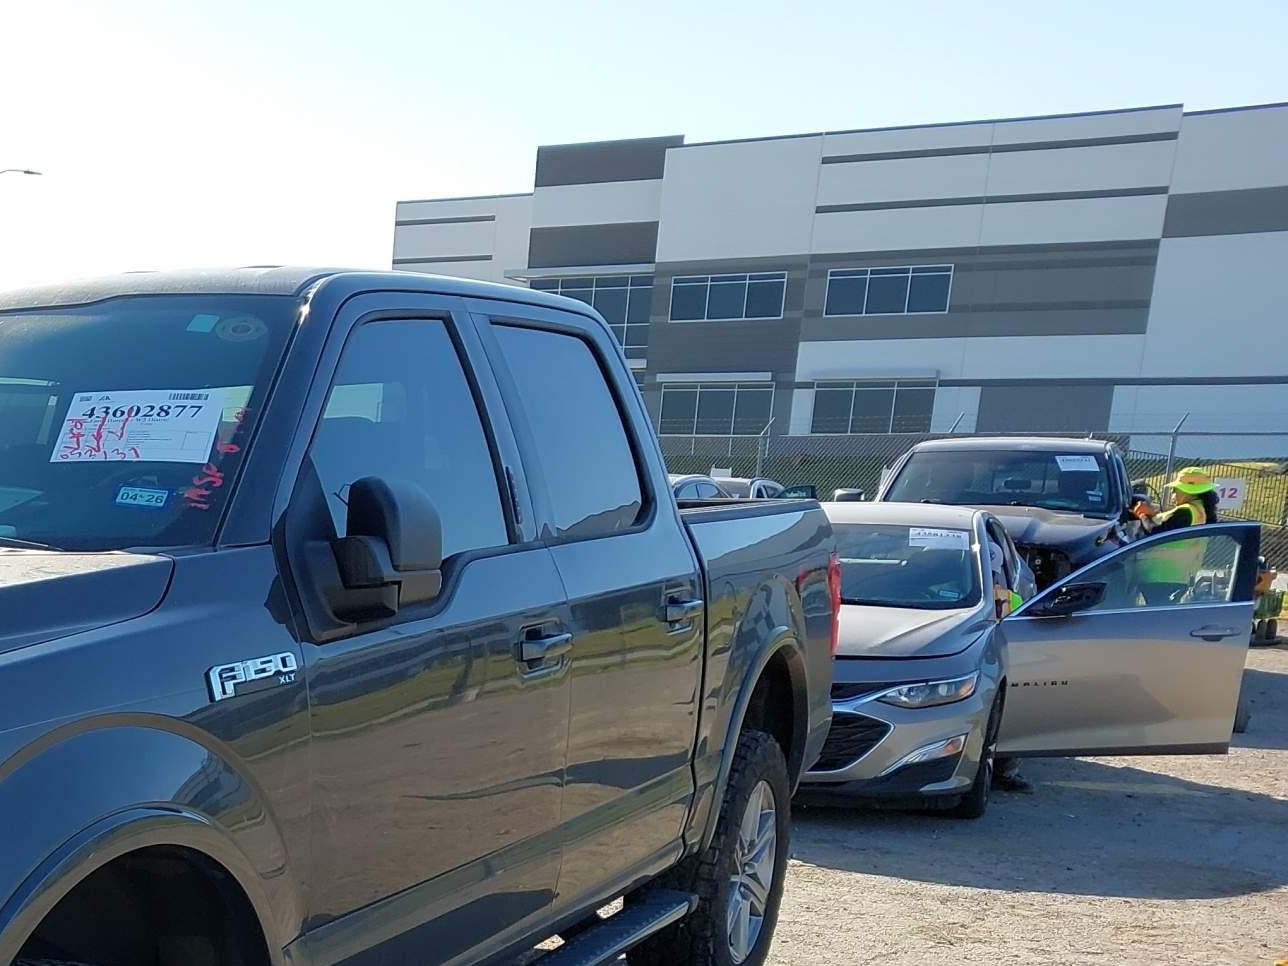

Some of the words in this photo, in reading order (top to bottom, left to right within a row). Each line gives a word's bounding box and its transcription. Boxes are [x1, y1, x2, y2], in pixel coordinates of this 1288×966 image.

[82, 404, 203, 419] 43602877
[120, 491, 139, 502] 04
[144, 494, 165, 504] 26
[1219, 487, 1238, 499] 12
[278, 673, 296, 685] XLT
